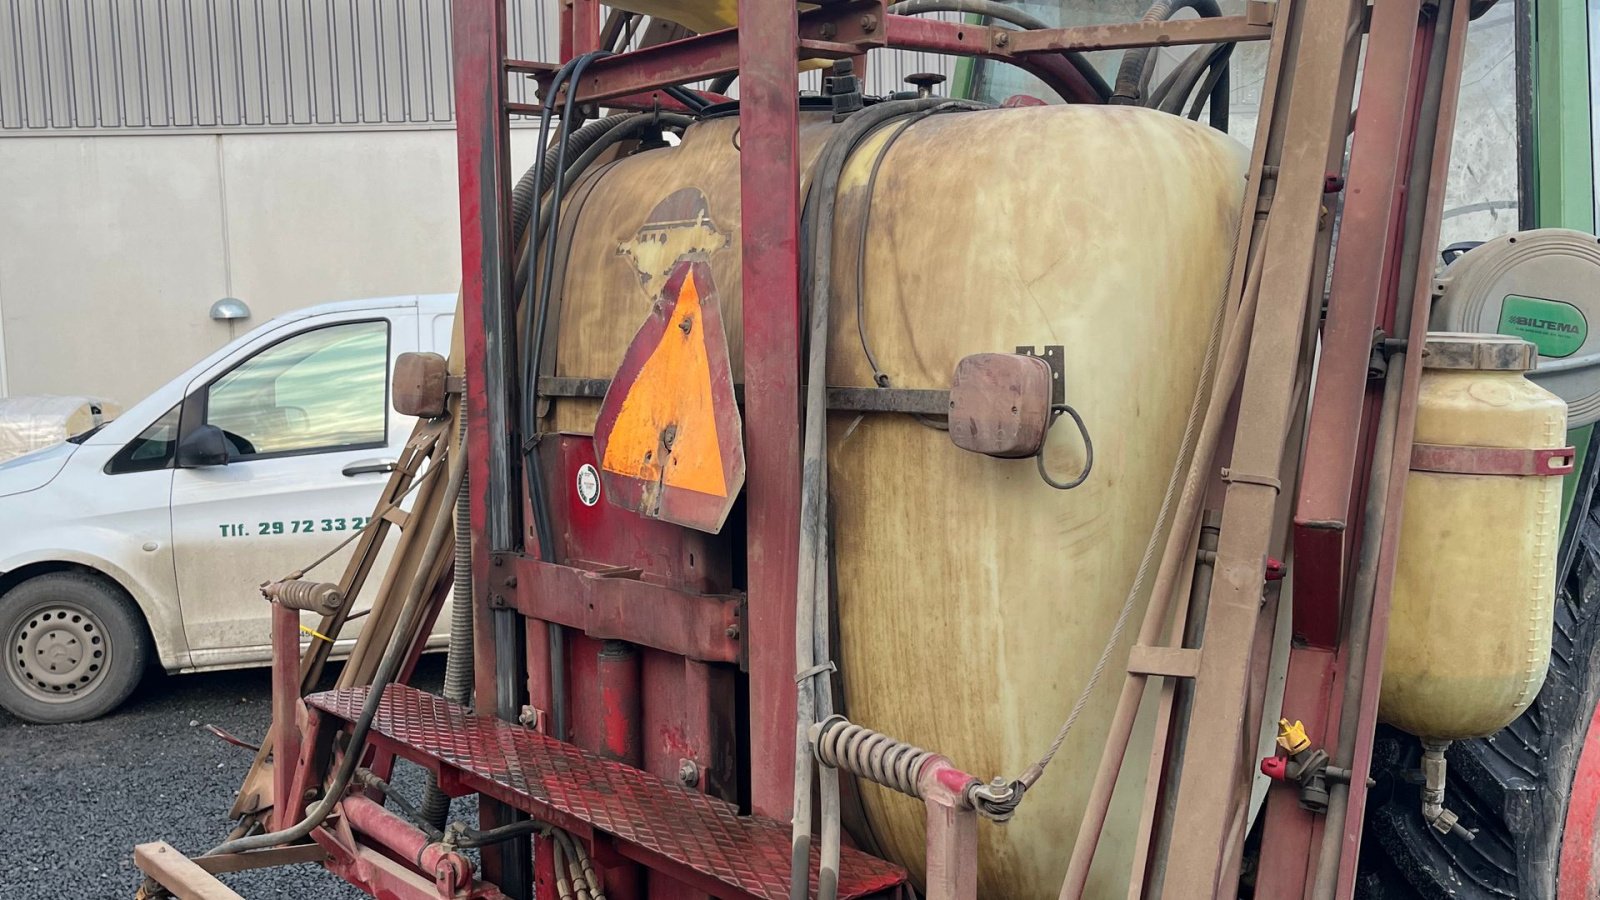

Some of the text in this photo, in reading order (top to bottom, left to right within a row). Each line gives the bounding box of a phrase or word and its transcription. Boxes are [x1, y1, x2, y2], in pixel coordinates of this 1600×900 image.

[1516, 316, 1579, 334] BILTEMA
[219, 517, 371, 537] Tlf. 29 72 33 2
